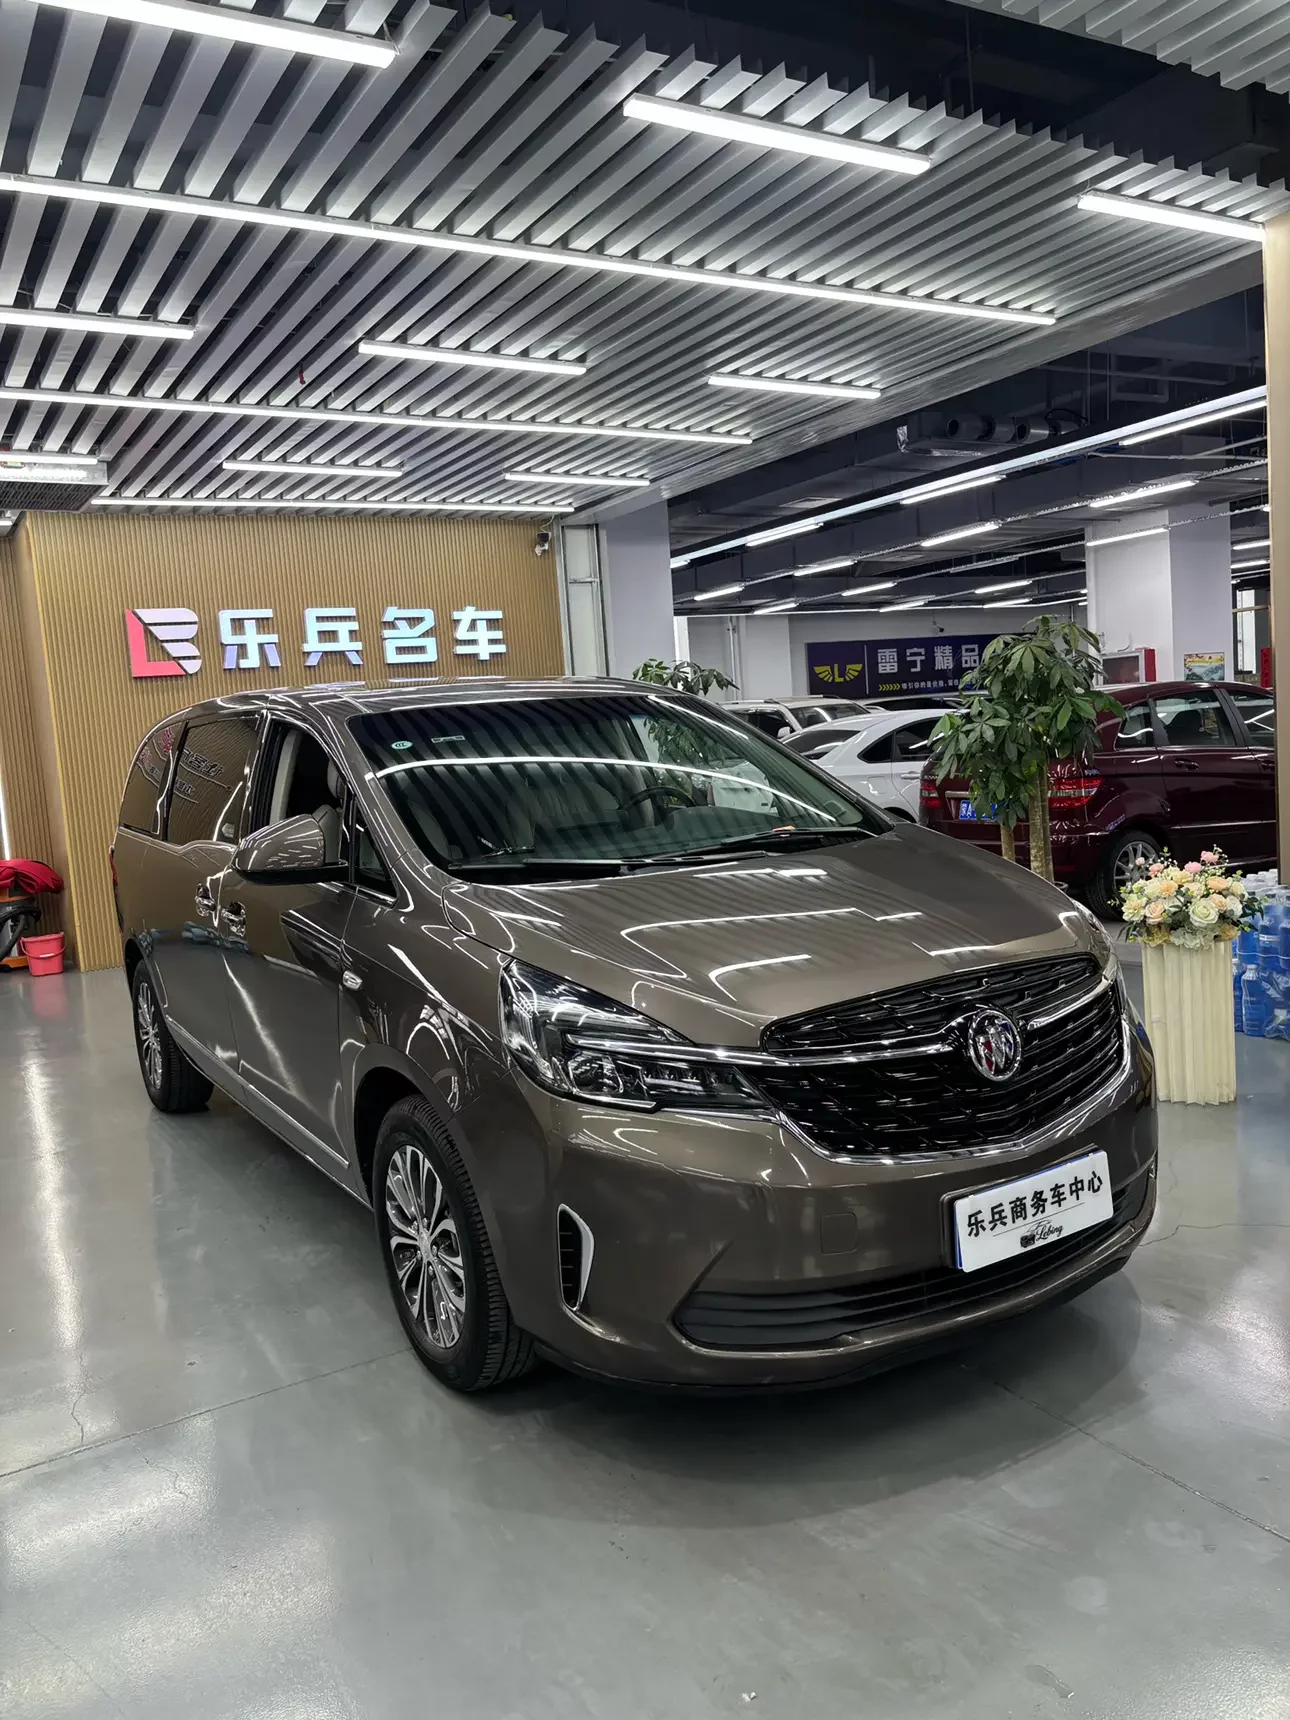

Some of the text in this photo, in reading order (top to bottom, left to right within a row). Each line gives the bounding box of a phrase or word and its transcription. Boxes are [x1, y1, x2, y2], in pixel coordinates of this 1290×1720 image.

[219, 606, 507, 669] 乐兵名车
[966, 1171, 1103, 1237] 乐兵商务车中心
